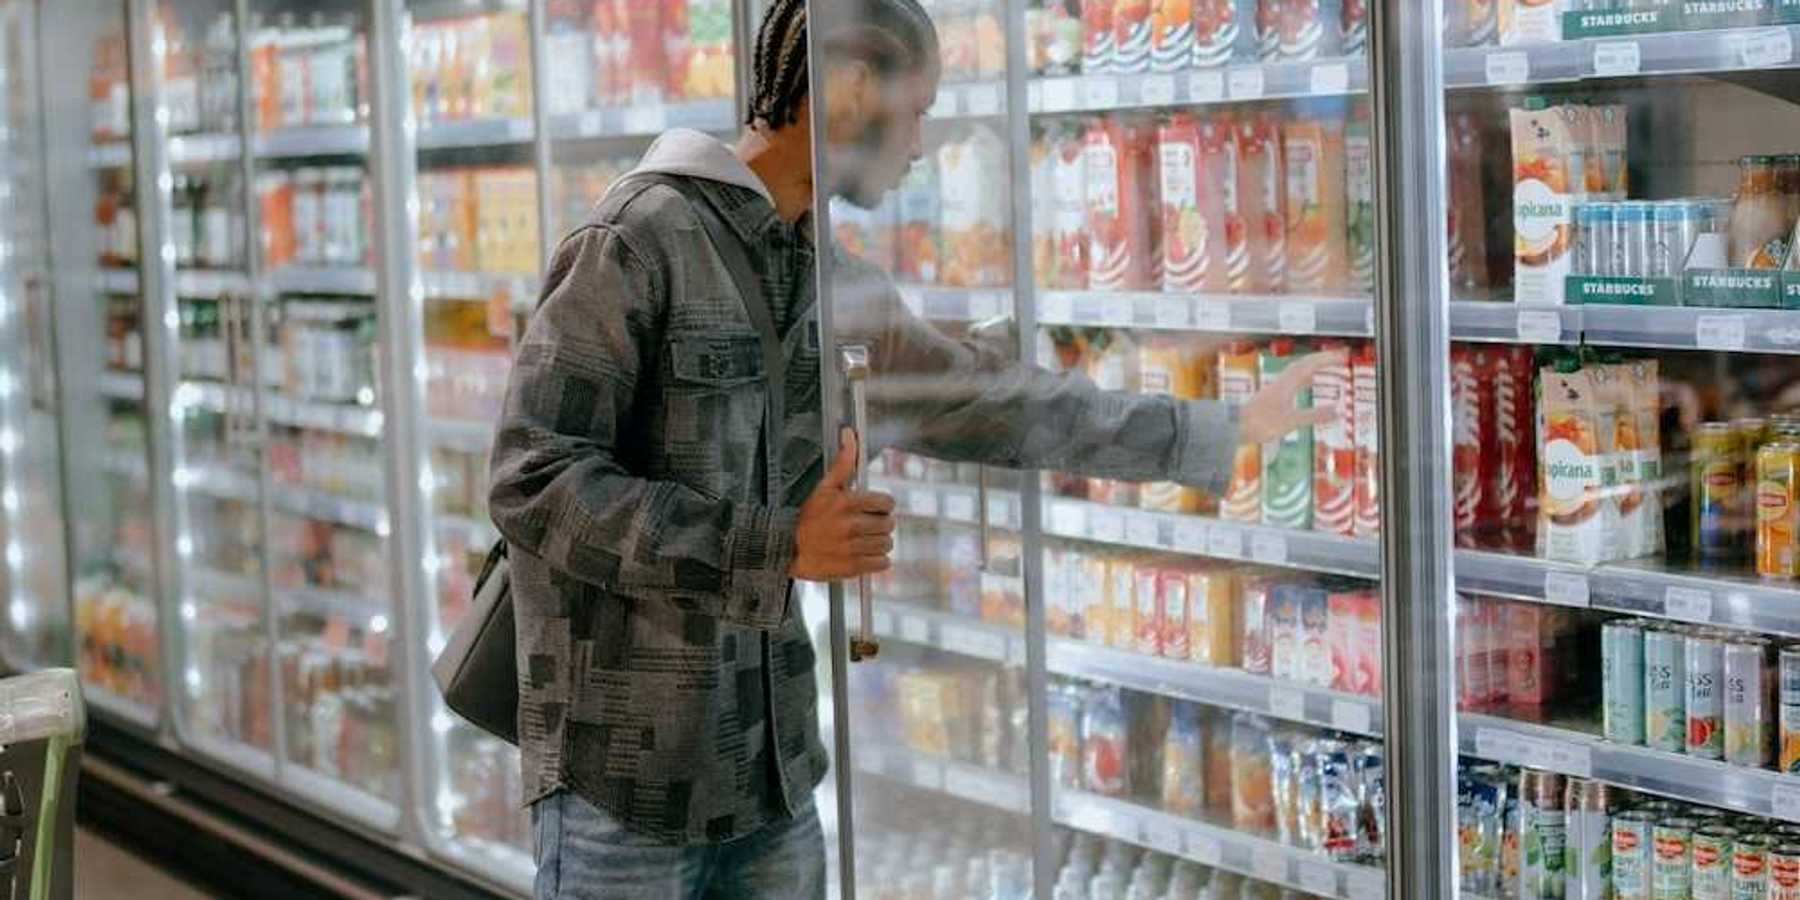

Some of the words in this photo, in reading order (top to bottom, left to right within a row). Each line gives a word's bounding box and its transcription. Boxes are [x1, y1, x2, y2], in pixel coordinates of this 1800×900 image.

[1685, 0, 1763, 14] STARBUCKS
[1580, 11, 1657, 27] STARBUCKS
[1583, 282, 1654, 296] STARBUCKS
[1692, 275, 1772, 289] STARBUCKS
